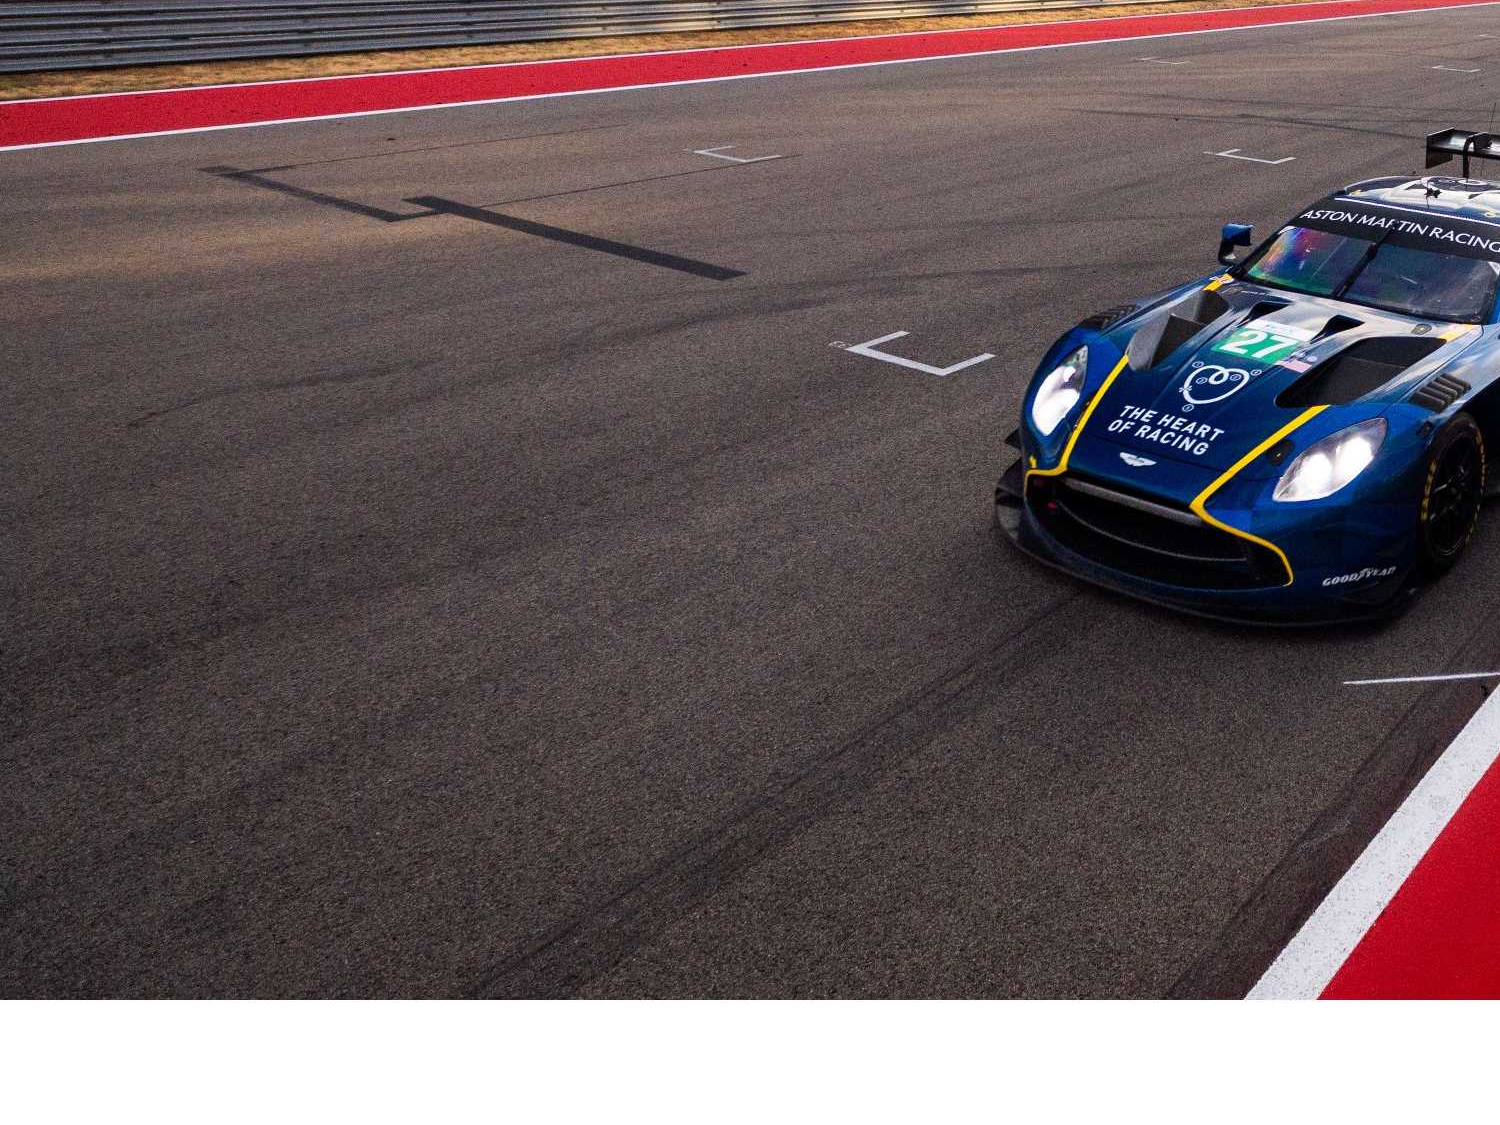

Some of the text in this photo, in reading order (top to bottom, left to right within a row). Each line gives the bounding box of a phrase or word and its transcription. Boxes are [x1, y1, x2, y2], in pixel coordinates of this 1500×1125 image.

[1300, 209, 1354, 223] ASTON
[1219, 331, 1298, 359] 27
[1108, 419, 1210, 456] OF RACING
[1120, 405, 1225, 442] THE HEART
[1322, 565, 1397, 587] GOODYEAR
